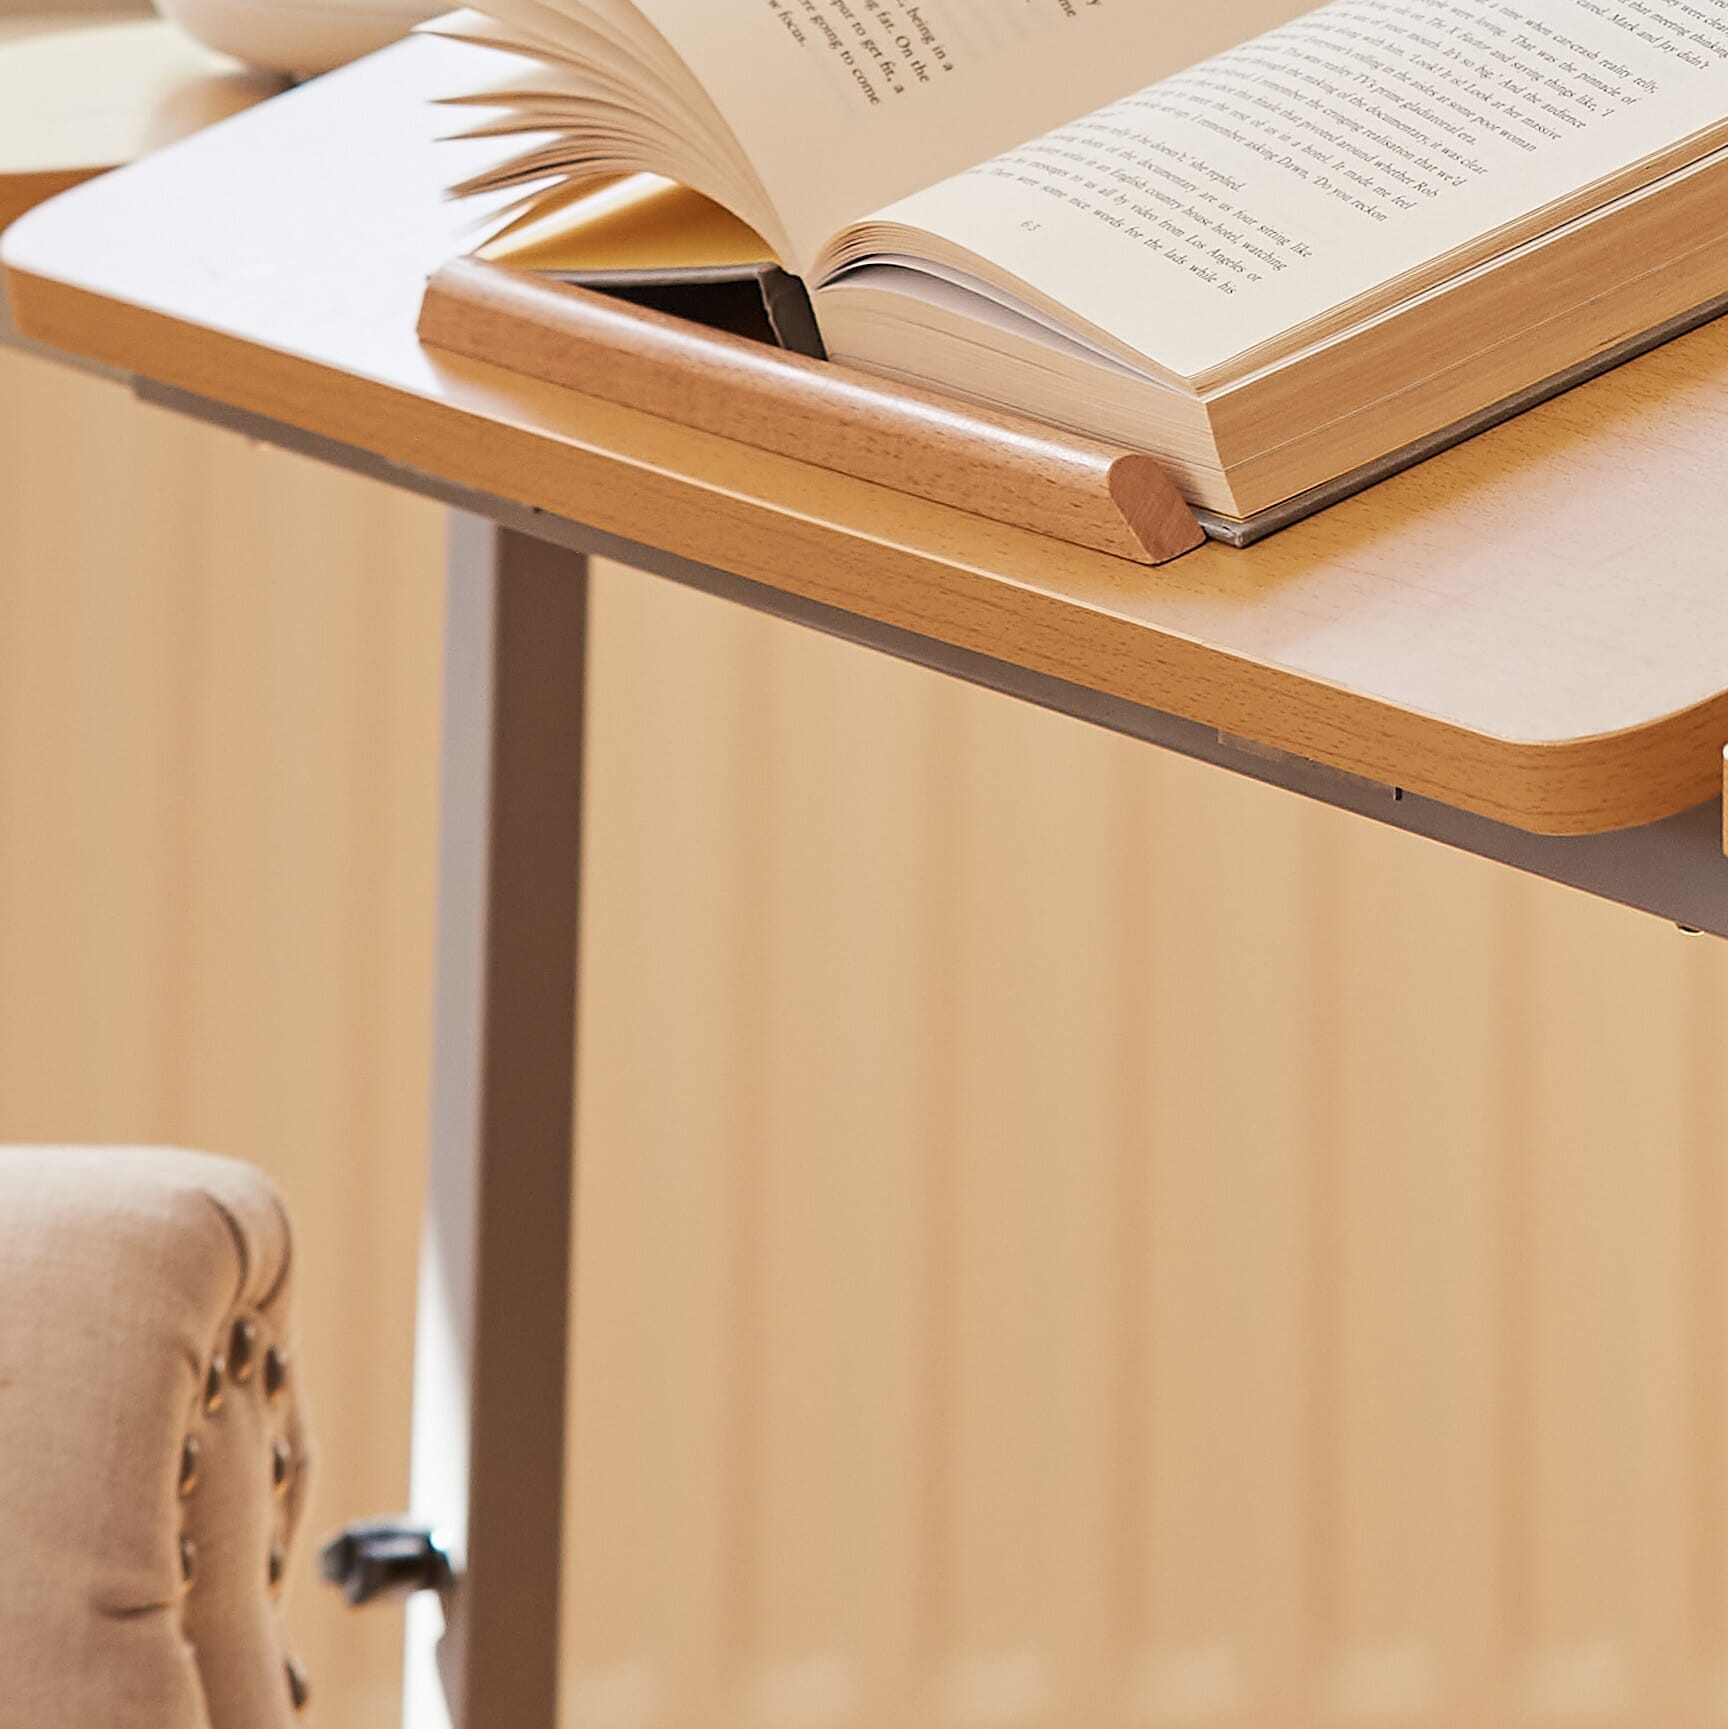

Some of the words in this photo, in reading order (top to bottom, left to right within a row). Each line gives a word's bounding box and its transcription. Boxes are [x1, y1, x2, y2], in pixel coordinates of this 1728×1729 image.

[778, 11, 805, 46] focus.
[906, 7, 934, 43] being
[1607, 14, 1639, 31] Mark
[1636, 32, 1663, 42] and
[1653, 40, 1677, 52] Jay
[1650, 13, 1690, 35] meeting
[810, 15, 842, 49] going
[852, 68, 879, 103] come
[860, 39, 882, 57] get
[880, 61, 894, 81] fit,
[876, 11, 894, 33] fat.
[910, 60, 929, 81] the
[1510, 62, 1543, 80] saying
[1544, 79, 1575, 97] things
[1575, 94, 1596, 111] like,
[1558, 62, 1576, 72] the
[1574, 73, 1620, 95] pinnacle
[1598, 60, 1632, 78] reality
[1633, 77, 1657, 93] telly,
[1498, 80, 1527, 93] And
[1522, 92, 1541, 103] the
[1541, 104, 1585, 127] audience
[1502, 105, 1522, 118] her
[1521, 117, 1561, 139] massive
[1399, 102, 1463, 133] gladiatorial
[1457, 133, 1475, 145] era.
[1447, 102, 1475, 116] some
[1470, 116, 1500, 130] poor
[1499, 130, 1535, 151] woman
[1336, 141, 1378, 161] around
[1374, 161, 1414, 183] whether
[1412, 181, 1438, 197] Rob
[1362, 130, 1414, 159] realisation
[1413, 158, 1437, 171] that
[1441, 147, 1462, 159] was
[1460, 159, 1487, 173] clear
[1189, 161, 1208, 171] she
[1206, 170, 1245, 191] replied.
[1343, 170, 1373, 186] made
[1391, 195, 1417, 209] feel
[1326, 188, 1352, 201] you
[1350, 200, 1386, 221] reckon
[1019, 218, 1042, 233] 63
[1182, 206, 1212, 225] house
[1242, 242, 1286, 270] watching
[1232, 209, 1257, 224] four
[1257, 225, 1290, 245] sitting
[1290, 242, 1311, 257] like
[1143, 239, 1162, 250] the
[1163, 248, 1187, 264] lads
[1189, 265, 1216, 282] while
[1217, 281, 1236, 293] his
[1185, 234, 1206, 248] Los
[1206, 249, 1245, 272] Angeles
